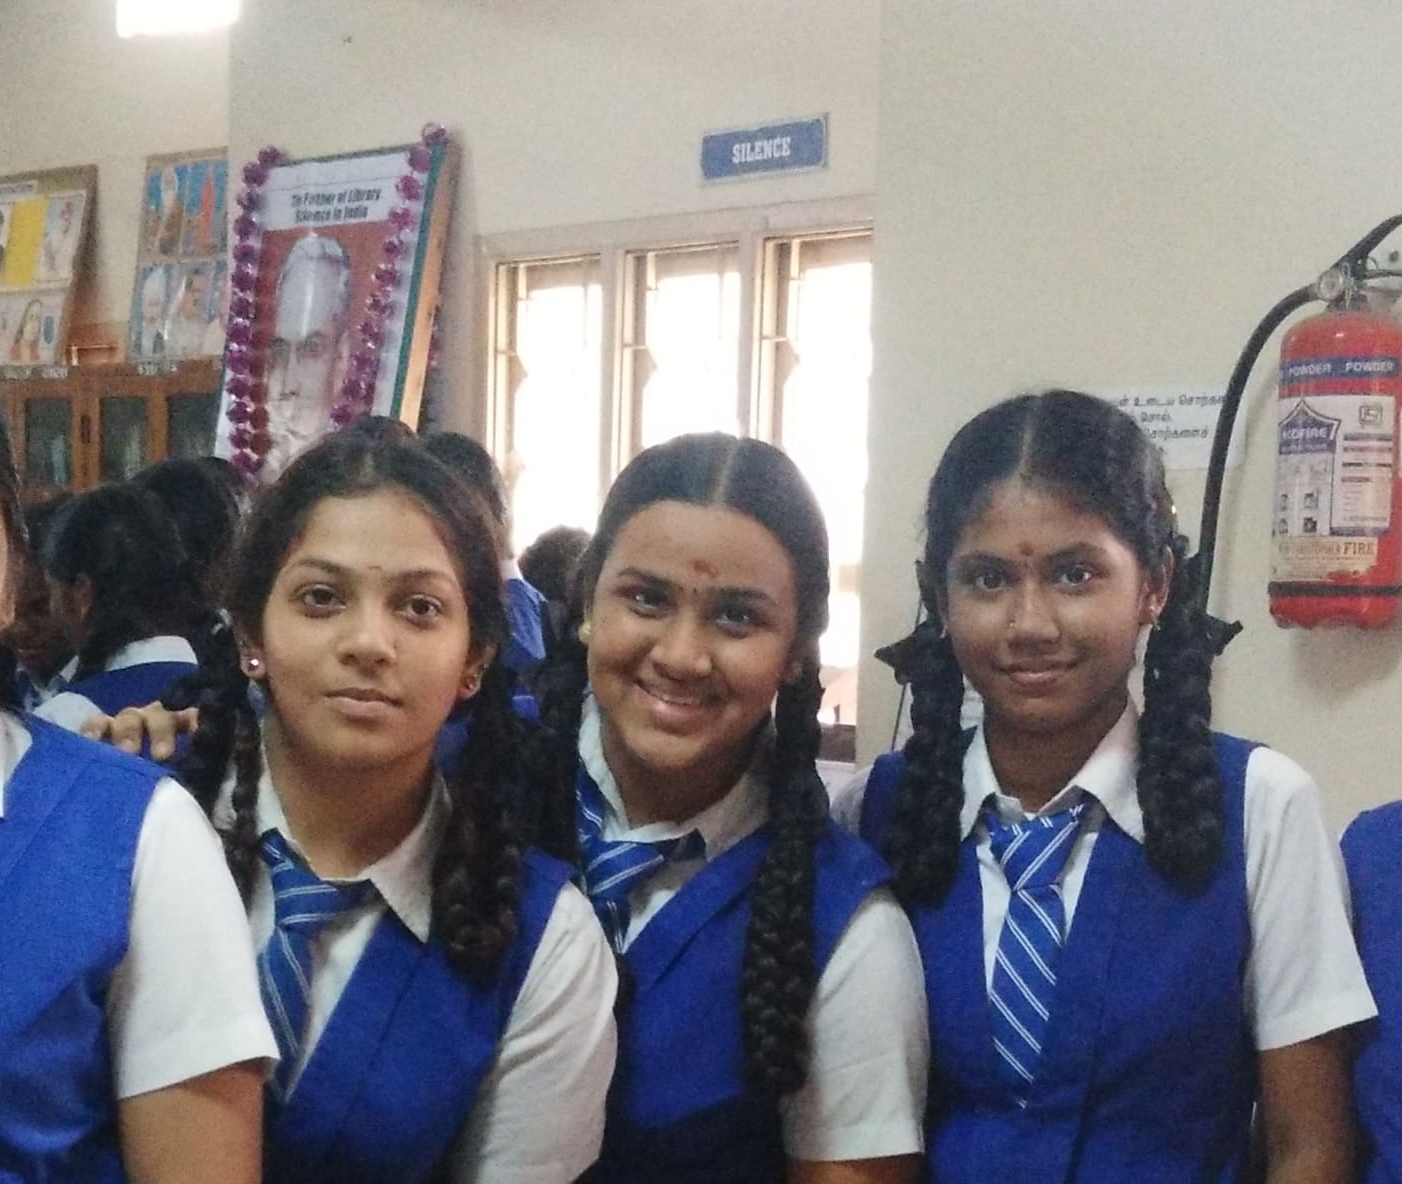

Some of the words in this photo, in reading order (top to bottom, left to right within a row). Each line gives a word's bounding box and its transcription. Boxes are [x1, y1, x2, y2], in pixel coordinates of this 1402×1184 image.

[732, 136, 791, 164] SILENCE
[347, 188, 381, 202] Library
[344, 206, 368, 219] India
[1345, 361, 1395, 373] POWDER
[1343, 542, 1375, 556] FIRE
